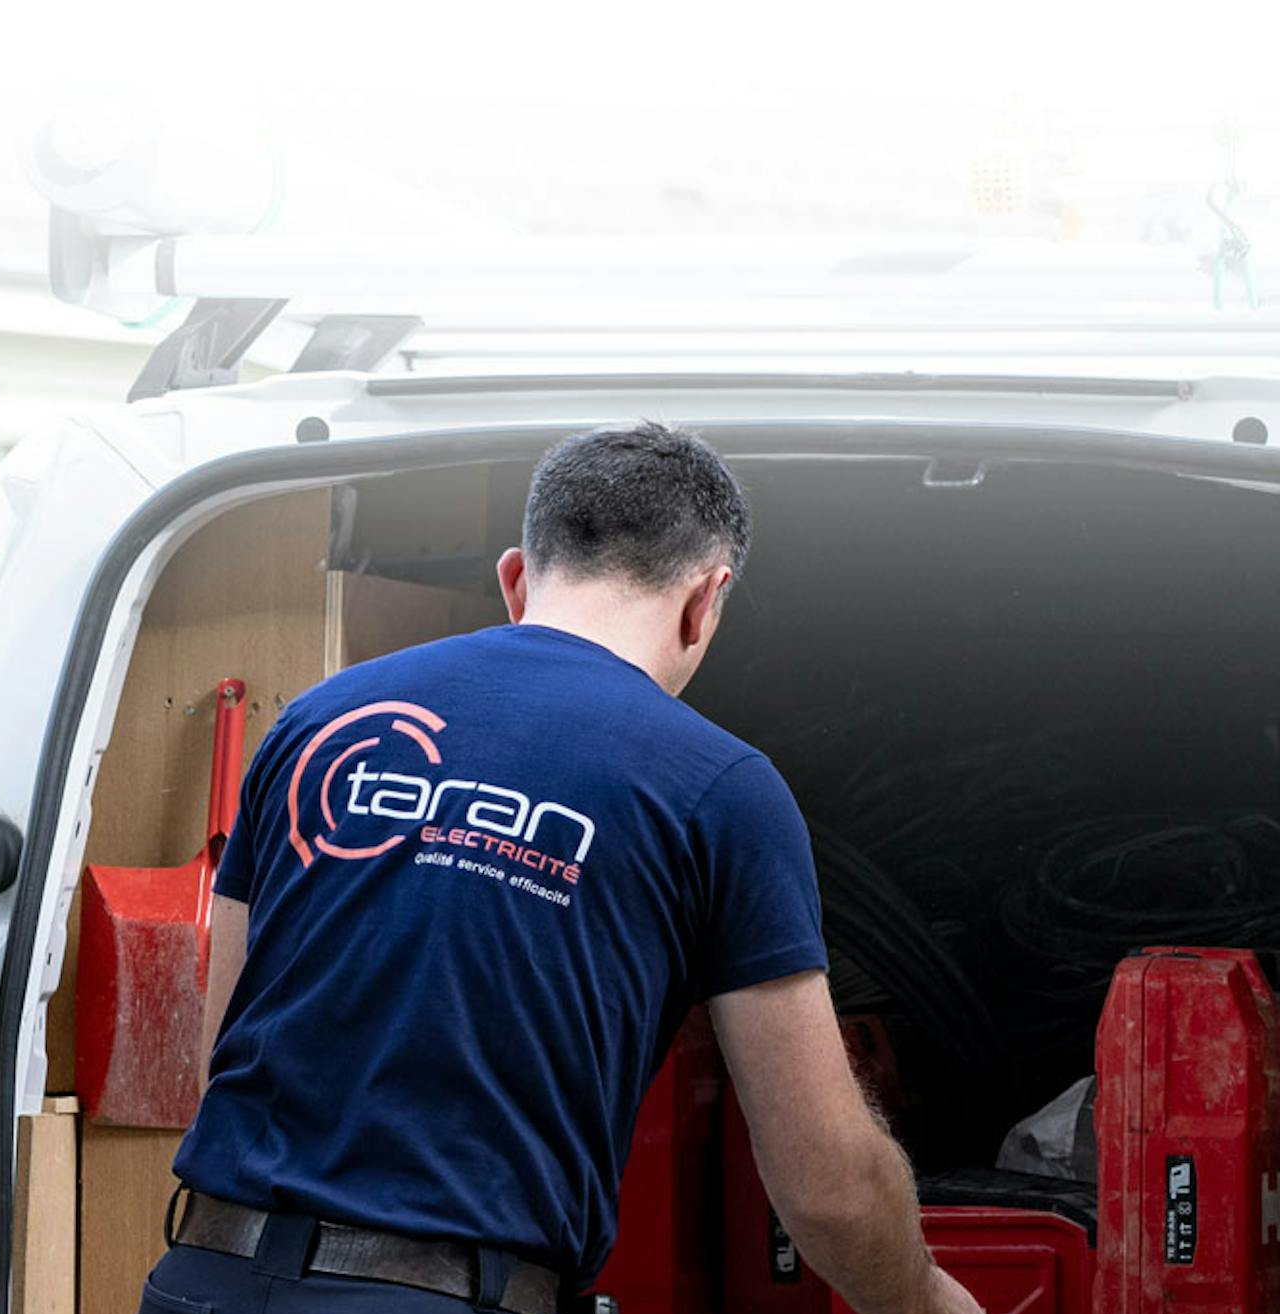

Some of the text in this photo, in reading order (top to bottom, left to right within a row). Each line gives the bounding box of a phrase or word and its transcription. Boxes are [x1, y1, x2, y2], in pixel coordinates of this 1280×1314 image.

[347, 761, 596, 863] taran
[420, 825, 581, 885] ELECTRICITÉ
[457, 858, 505, 881] service
[509, 875, 571, 907] efficacité
